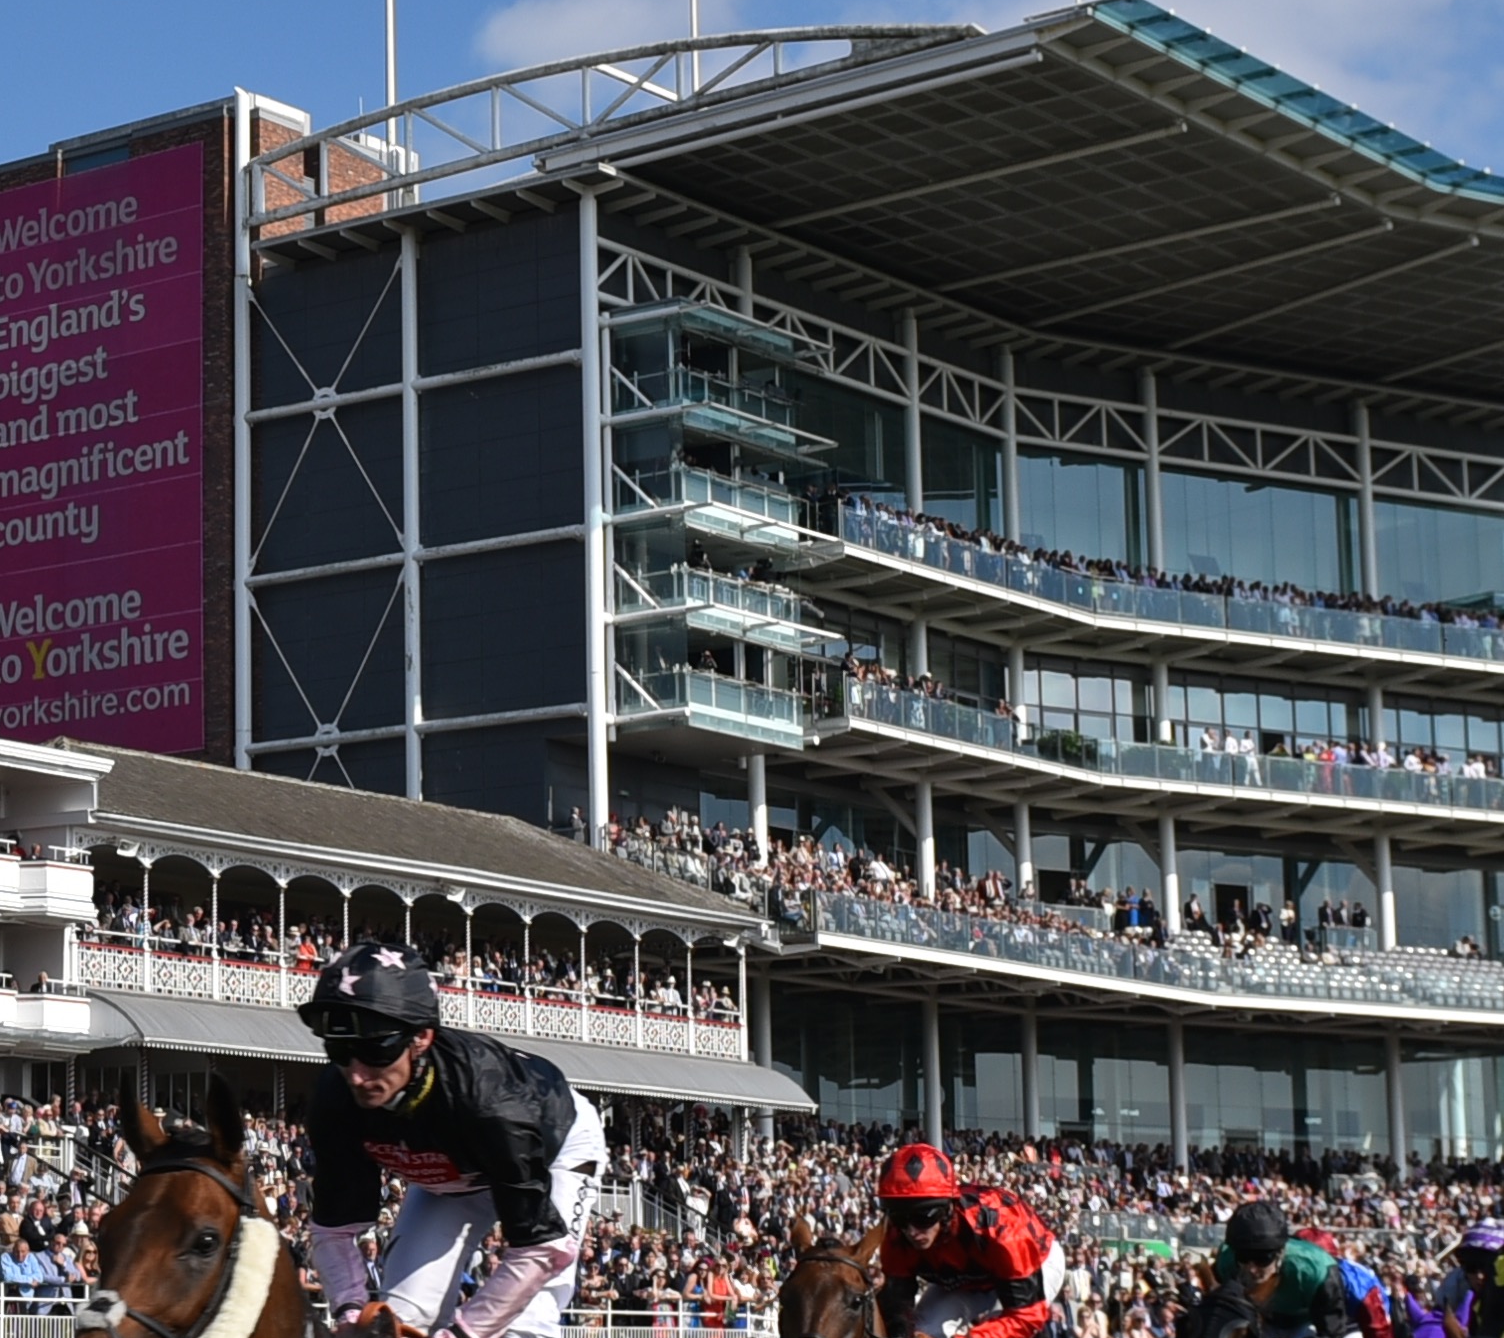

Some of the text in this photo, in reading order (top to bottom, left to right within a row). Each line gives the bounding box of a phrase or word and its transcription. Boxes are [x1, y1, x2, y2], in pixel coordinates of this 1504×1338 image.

[25, 232, 179, 293] Yorkshire
[57, 390, 139, 437] most
[25, 625, 191, 682] Yorkshire
